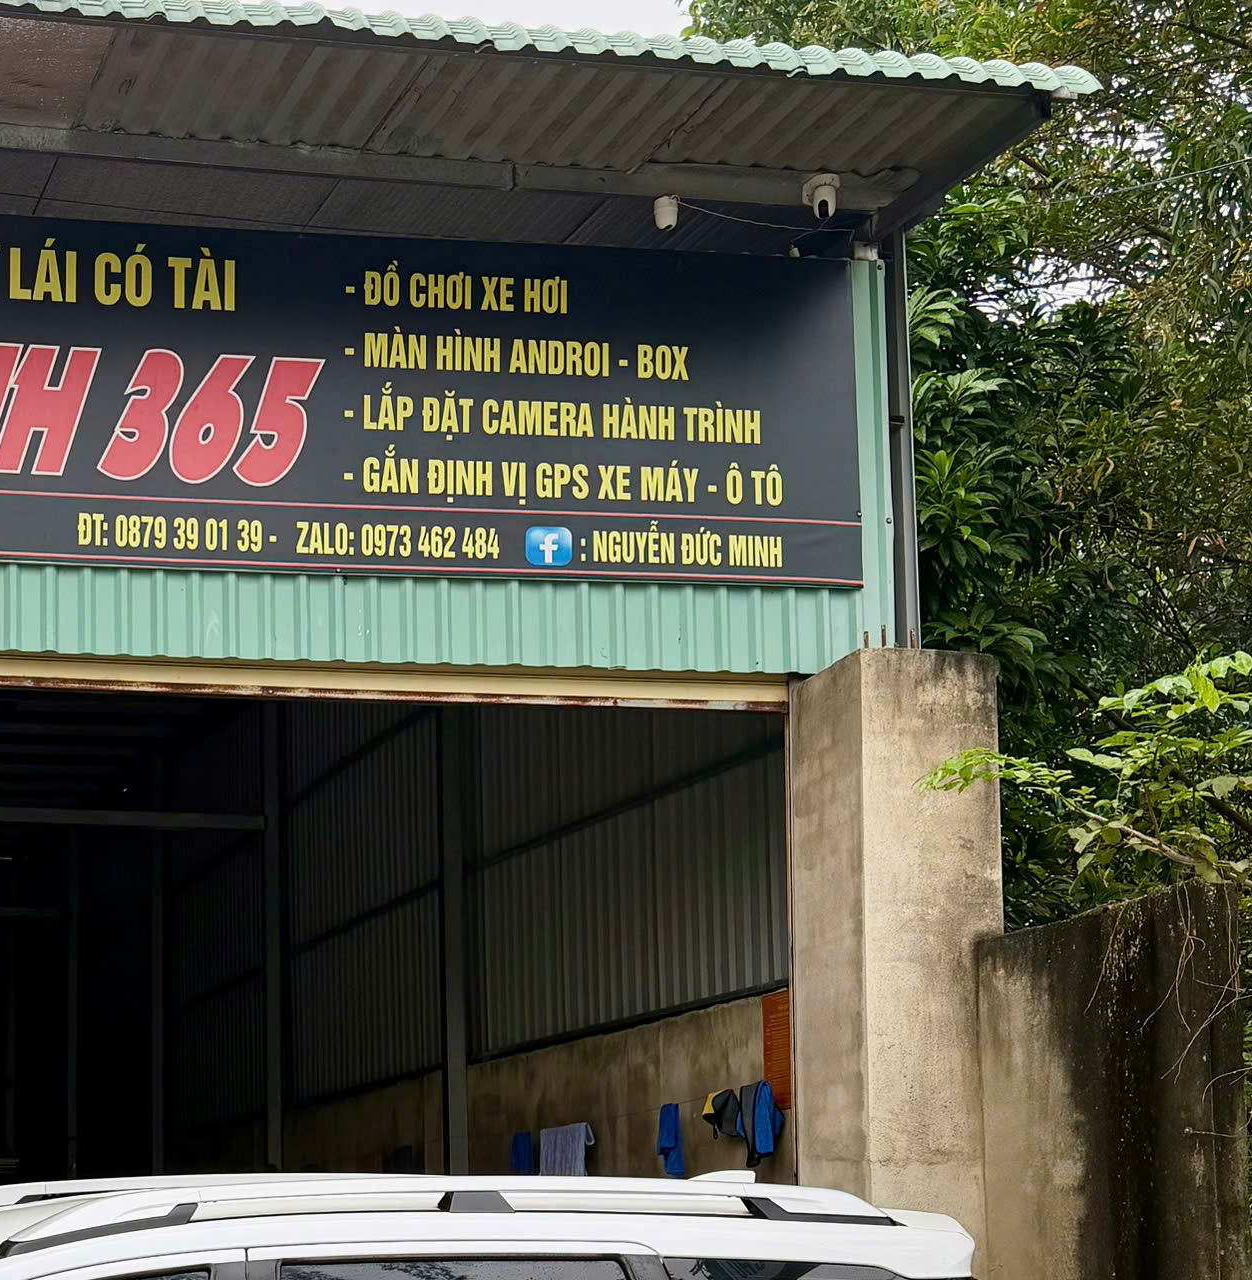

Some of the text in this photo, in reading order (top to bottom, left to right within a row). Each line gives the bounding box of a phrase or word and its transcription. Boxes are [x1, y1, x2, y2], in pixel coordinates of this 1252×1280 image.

[9, 239, 77, 303] LÁI
[94, 243, 153, 308] CÓ
[167, 247, 236, 312] TÀI
[363, 264, 400, 307] ĐỒ
[409, 271, 472, 310] CHƠI
[480, 276, 515, 312] XE
[523, 276, 568, 314] HƠI
[363, 327, 427, 370] MÀN
[436, 330, 501, 373] HÌNH
[508, 338, 610, 378] ANDROI
[637, 343, 689, 381] BOX
[97, 348, 326, 487] 365
[363, 383, 414, 432] LẮP
[421, 391, 474, 442] ĐẶT
[481, 399, 595, 438] CAMERA
[601, 397, 676, 441] HÀNH
[683, 401, 762, 445] TRÌNH
[362, 444, 419, 495] GẮN
[427, 458, 493, 504] ĐỊNH
[500, 462, 527, 506] VỊ
[535, 463, 589, 500] GPS
[597, 464, 632, 501] XE
[639, 459, 699, 503] MÁY
[725, 463, 744, 505] Ô
[750, 463, 783, 507] TÔ
[76, 512, 109, 549] ĐT:
[114, 514, 168, 550] 0879
[172, 516, 200, 551] 39
[204, 518, 229, 553] 01
[236, 519, 263, 553] 39
[295, 520, 355, 556] ZALO:
[360, 523, 412, 558] 0973
[417, 527, 457, 559] 462
[461, 527, 501, 561] 484
[592, 521, 676, 565] NGUYỄN
[680, 531, 723, 567] ĐỨC
[727, 535, 783, 569] MINH
